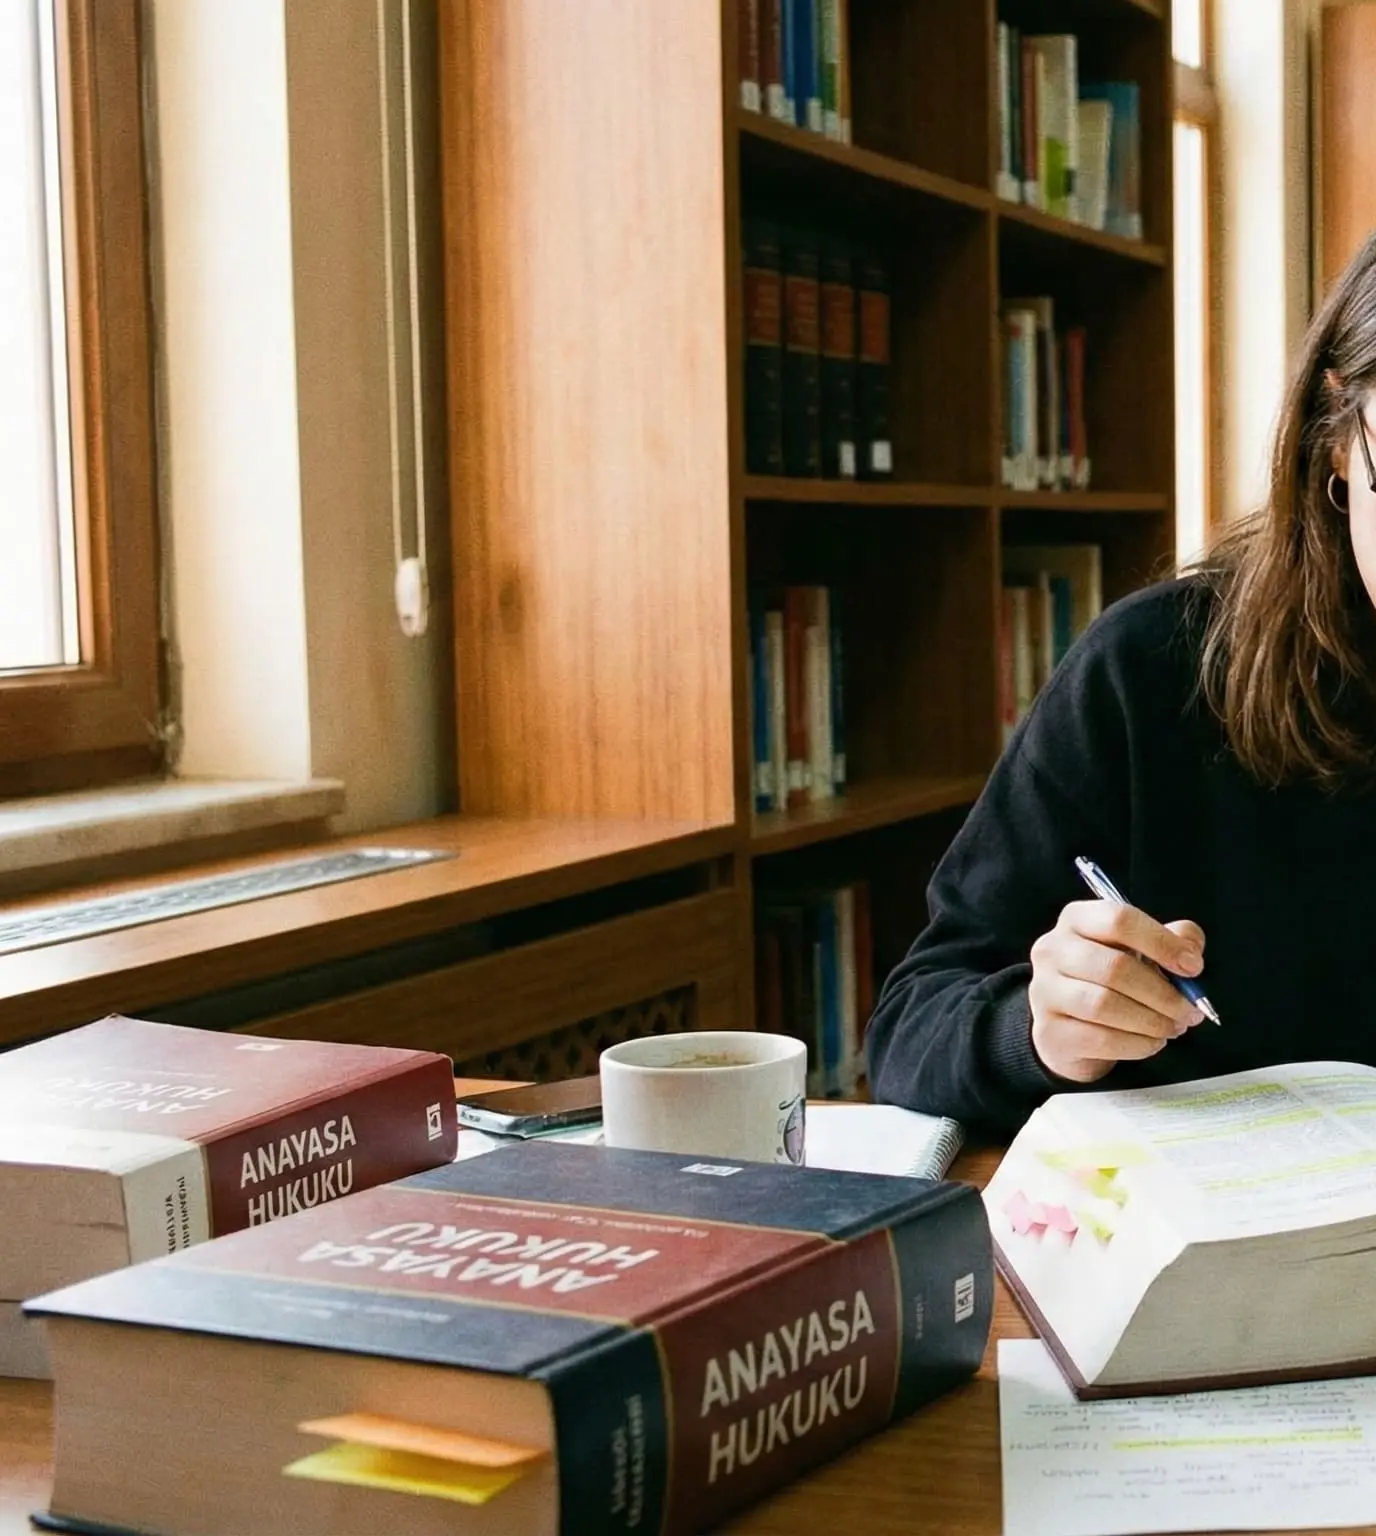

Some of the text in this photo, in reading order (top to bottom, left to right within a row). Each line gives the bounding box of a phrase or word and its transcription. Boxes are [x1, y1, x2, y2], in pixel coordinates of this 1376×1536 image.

[241, 1114, 356, 1189] ANAYASA
[248, 1158, 353, 1227] HUKUKU
[297, 1241, 619, 1293] ANAYASA
[365, 1222, 660, 1269] HUKUKU
[701, 1290, 876, 1417] ANAYASA
[708, 1355, 868, 1484] HUKUKU
